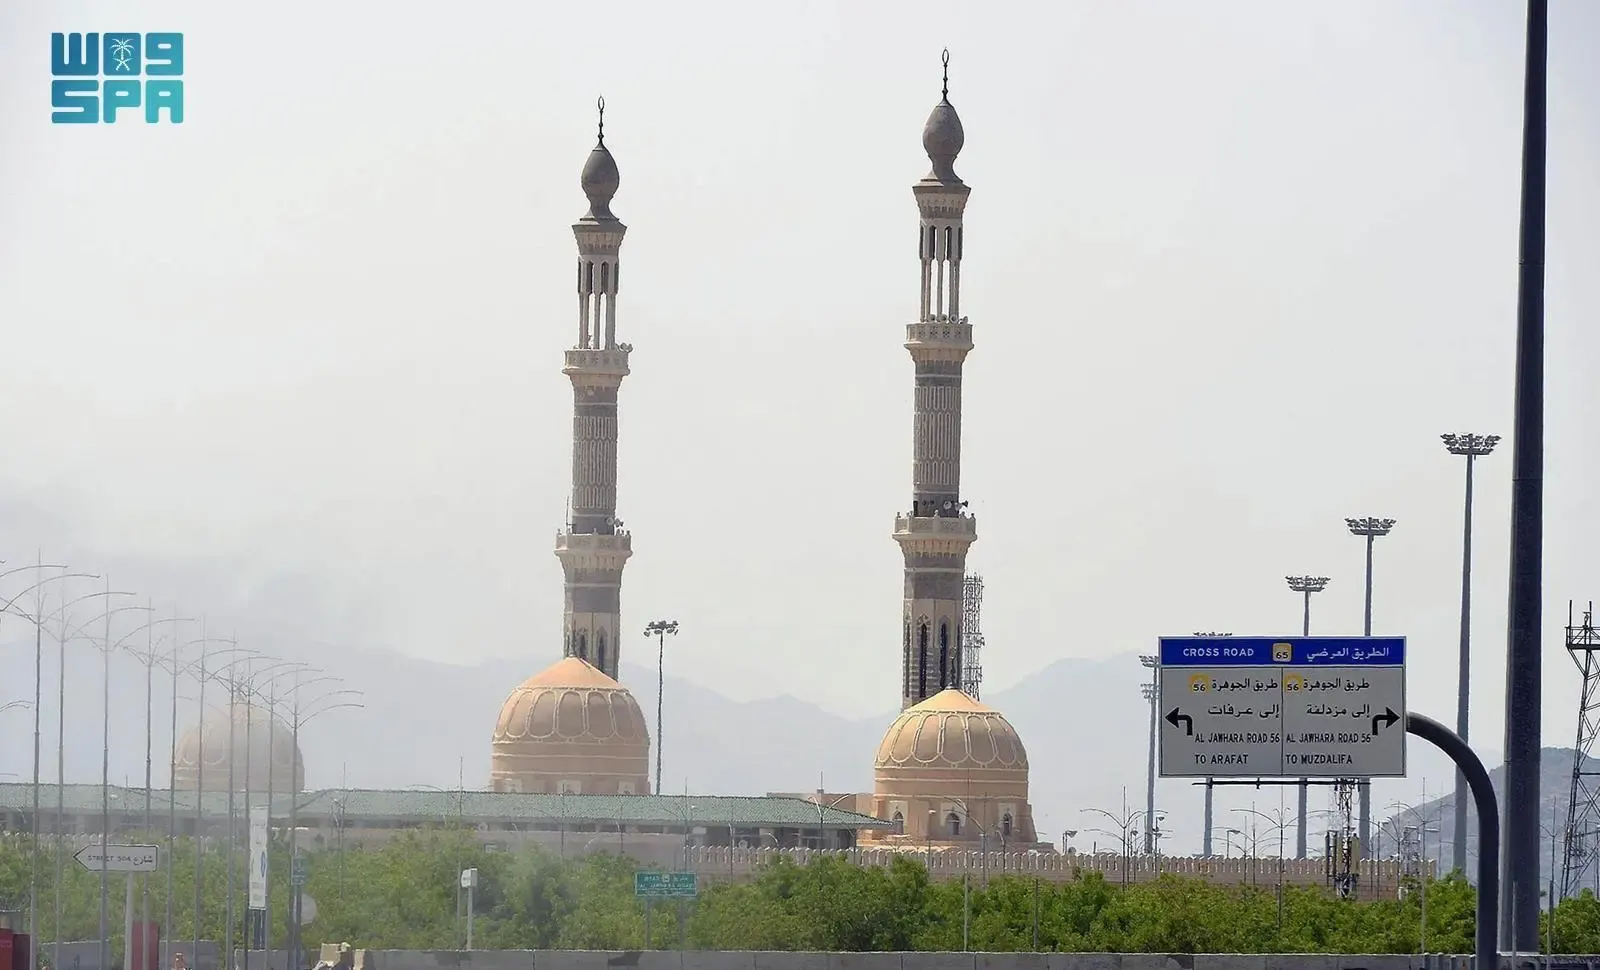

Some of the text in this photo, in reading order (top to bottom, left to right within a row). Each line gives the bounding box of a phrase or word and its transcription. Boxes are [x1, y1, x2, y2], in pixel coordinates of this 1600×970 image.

[1183, 648, 1254, 657] CROSS ROAD
[1275, 651, 1289, 660] 65
[1306, 647, 1389, 662] الطريق العرضي
[1193, 678, 1279, 692] طريق الجوهرة 56
[1286, 678, 1370, 692] طريق الجوهرة 56
[1207, 703, 1280, 719] إلى عرفات
[1306, 703, 1370, 719] إلى مزدلفة
[1195, 732, 1280, 744] AL JAWHARA ROAD 56
[1286, 732, 1371, 744] AL JAWHARA ROAD 56
[1194, 753, 1249, 765] TO ARAFAT
[1285, 753, 1353, 765] TO MUZDALIFA
